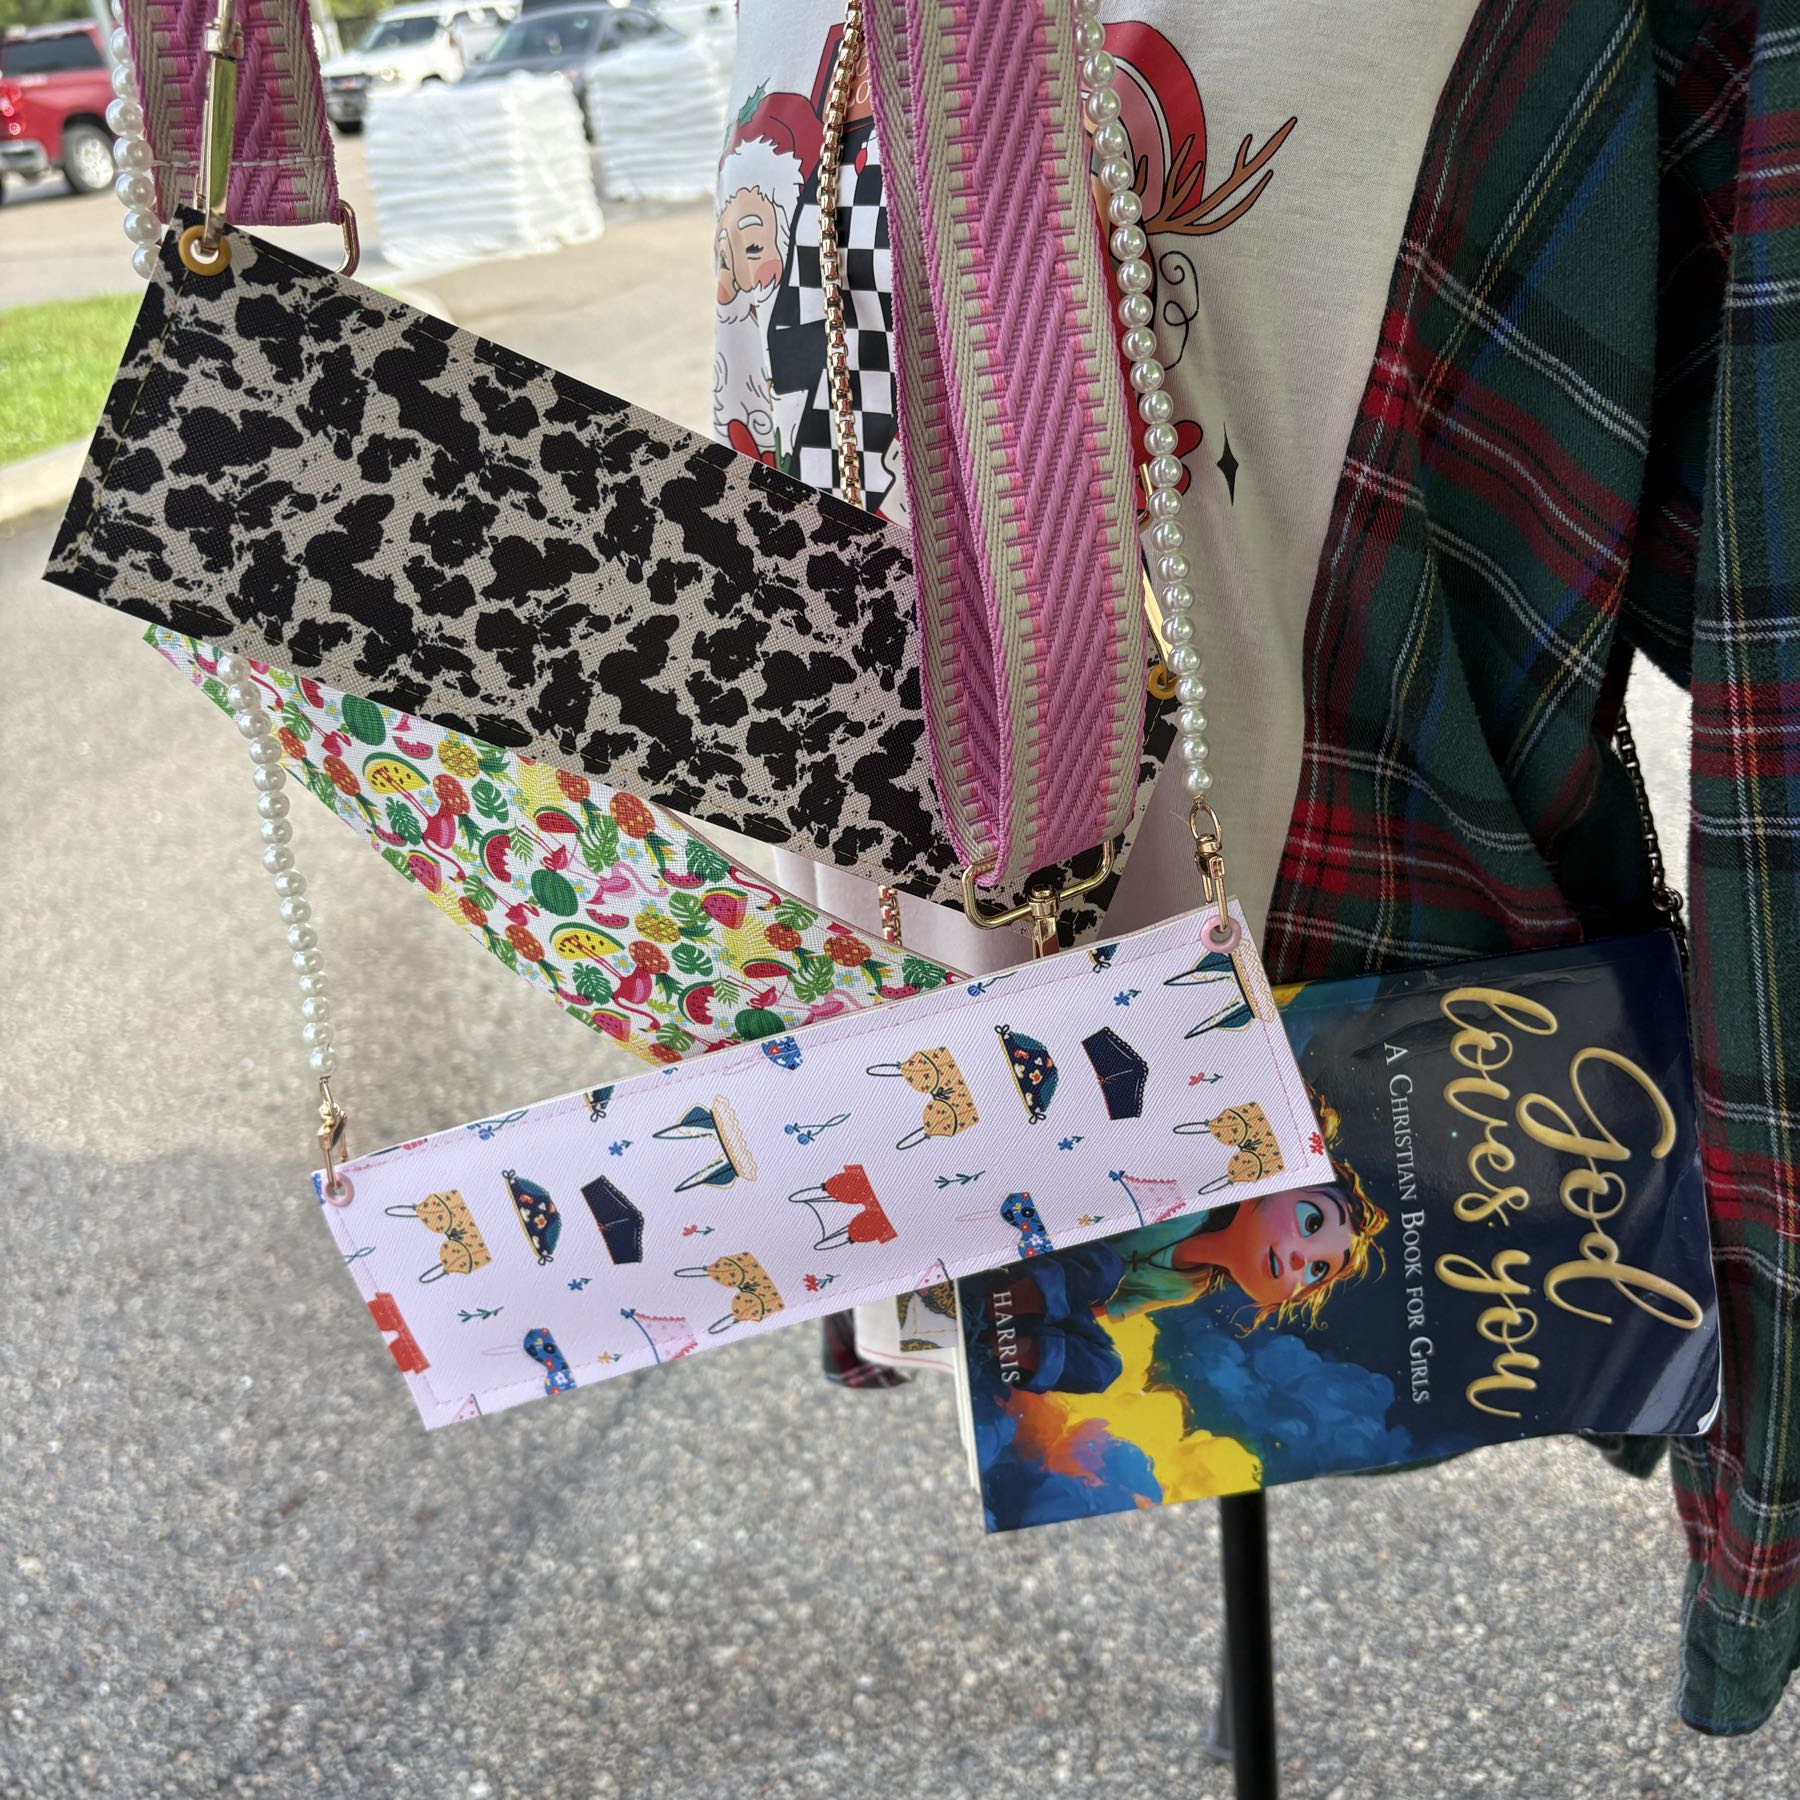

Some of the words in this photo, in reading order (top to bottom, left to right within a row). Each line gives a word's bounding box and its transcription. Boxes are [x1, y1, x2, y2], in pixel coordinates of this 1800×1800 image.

[1384, 1042, 1408, 1066] A
[1389, 1074, 1417, 1200] CHRISTIAN
[1516, 1047, 1702, 1329] God
[1401, 1209, 1425, 1279] BOOK
[993, 1290, 1020, 1383] HARRIS
[1406, 1287, 1425, 1329] FOR
[1434, 1249, 1540, 1418] you
[1409, 1336, 1434, 1404] GIRLS
